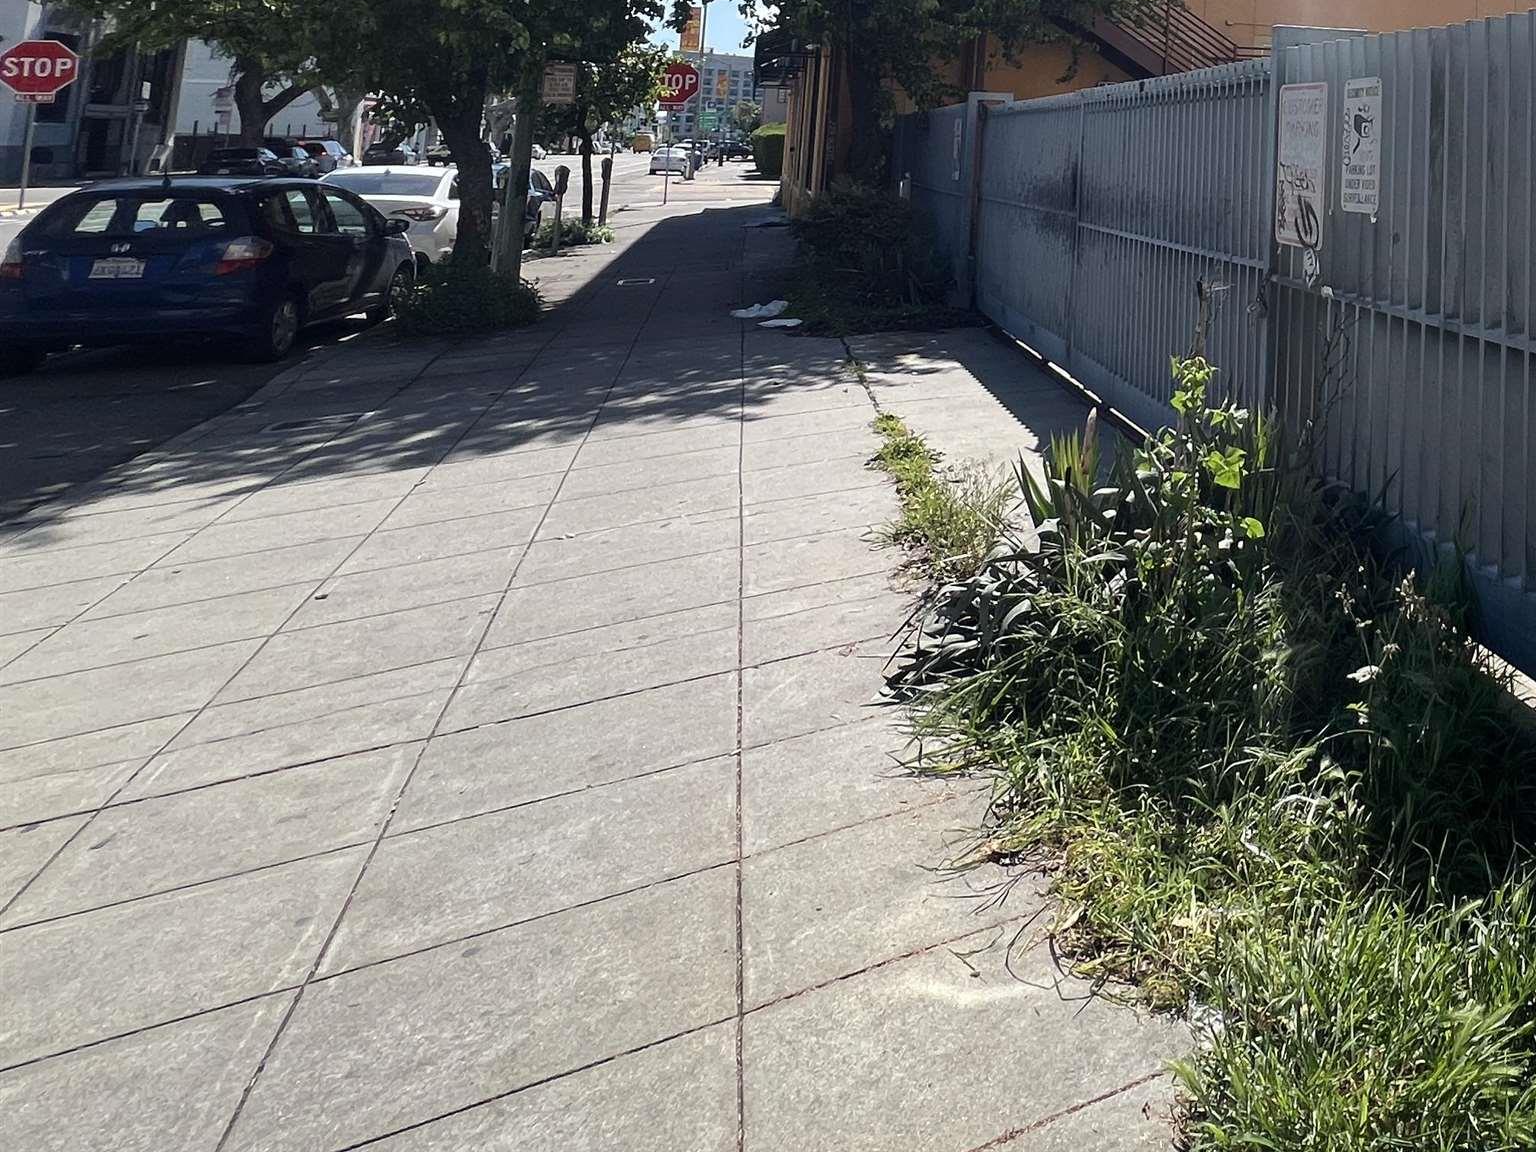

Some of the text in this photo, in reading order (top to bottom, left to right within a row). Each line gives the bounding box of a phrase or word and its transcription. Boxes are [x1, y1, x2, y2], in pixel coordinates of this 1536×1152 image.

[2, 57, 73, 77] STOP
[662, 73, 697, 90] TOP
[1345, 165, 1365, 176] PARKING
